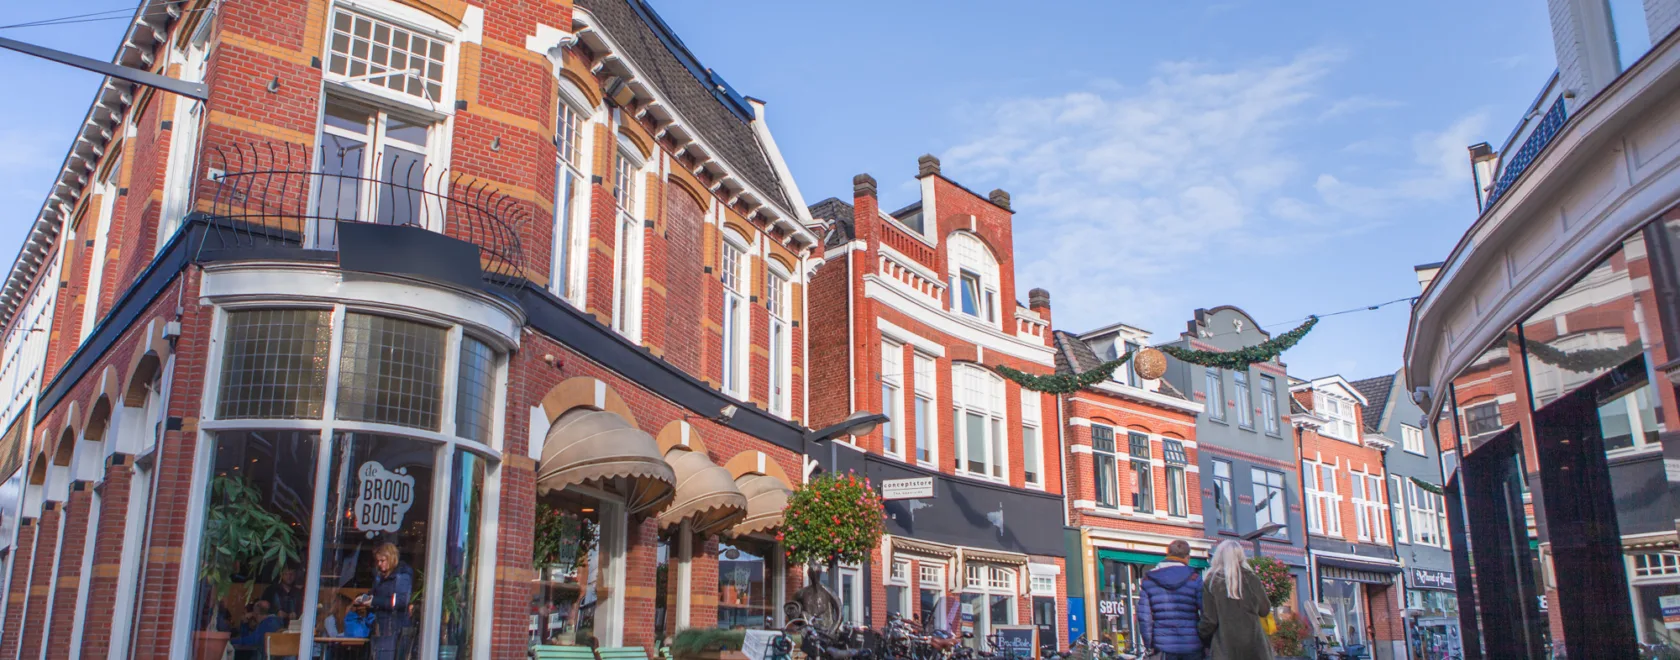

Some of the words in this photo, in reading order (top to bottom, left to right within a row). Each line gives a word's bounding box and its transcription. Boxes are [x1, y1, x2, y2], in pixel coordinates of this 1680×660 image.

[365, 464, 377, 477] de
[364, 479, 410, 504] BROOD
[883, 480, 932, 488] conceptstore
[362, 502, 398, 526] BODE
[1099, 600, 1124, 615] SBTG
